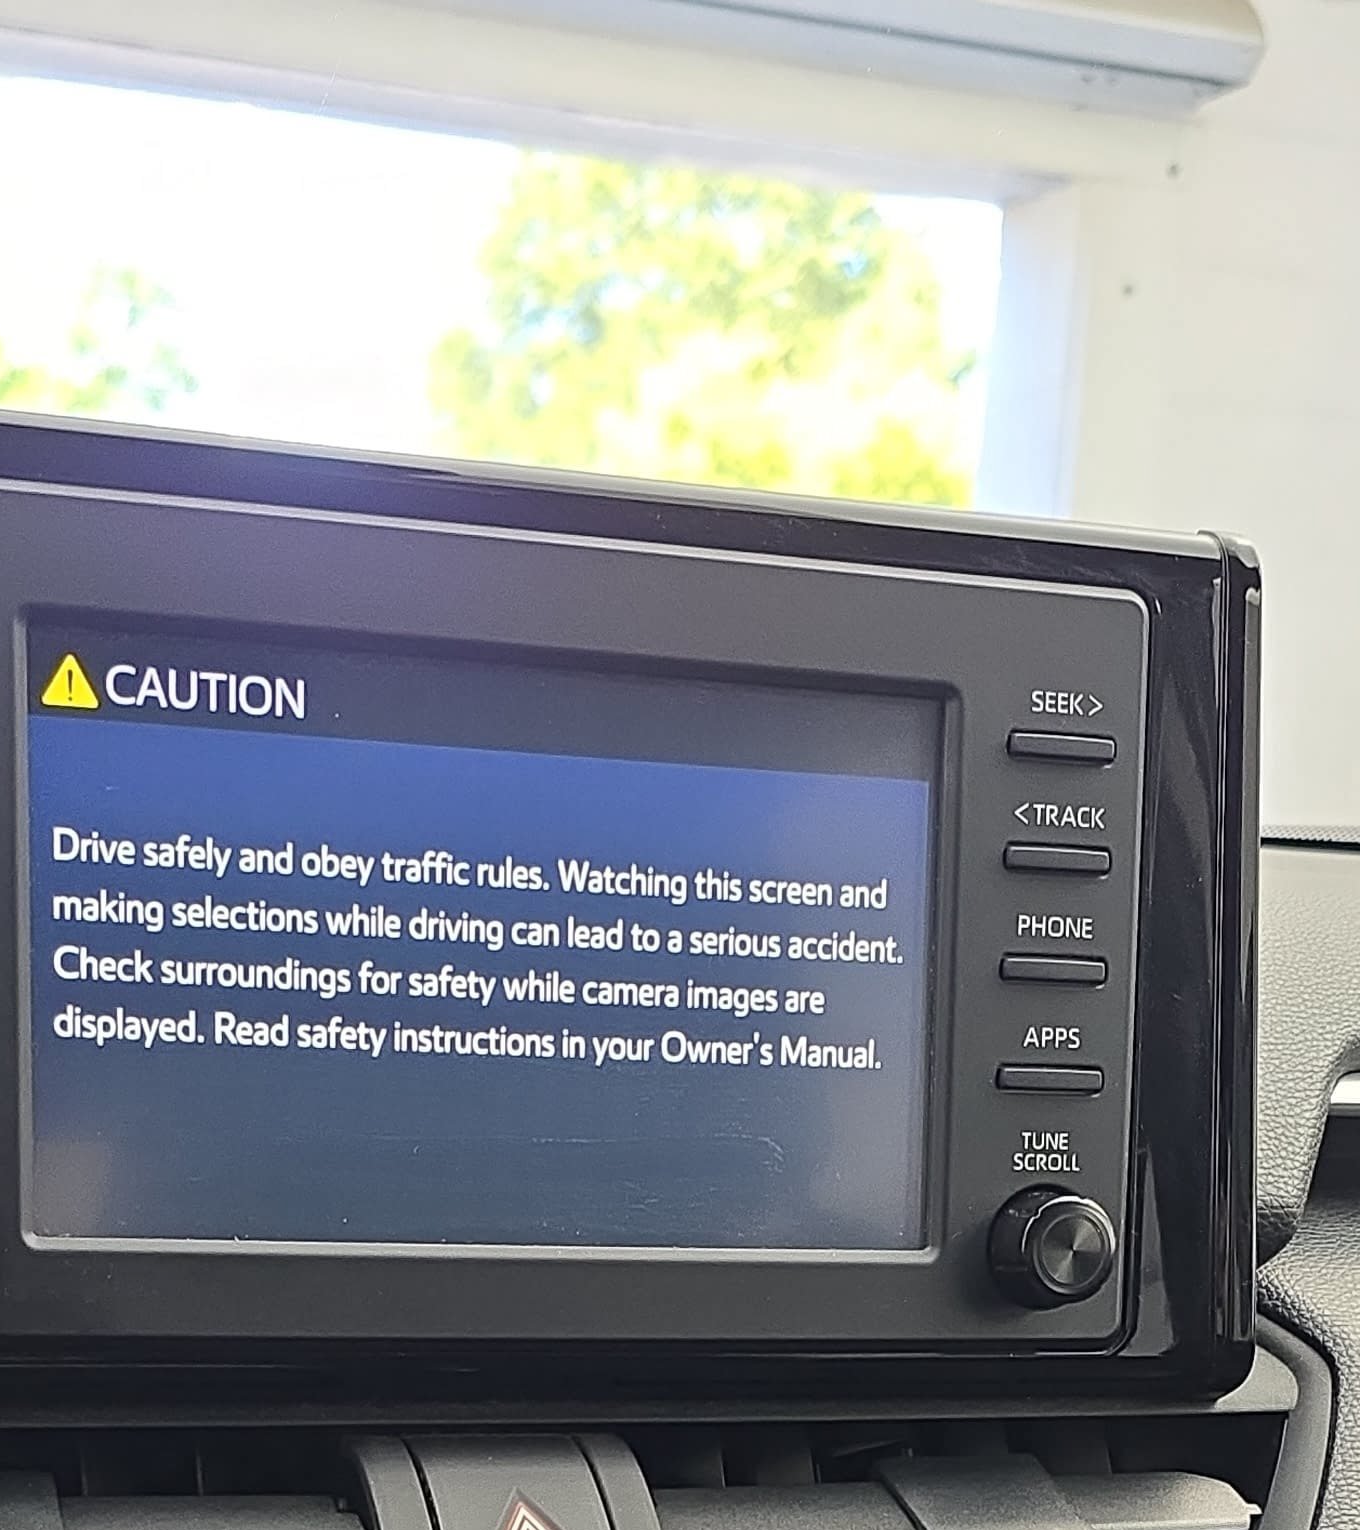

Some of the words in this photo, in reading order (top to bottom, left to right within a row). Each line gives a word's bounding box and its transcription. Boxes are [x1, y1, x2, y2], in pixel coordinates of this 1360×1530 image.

[105, 664, 305, 719] CAUTION
[52, 826, 136, 865] Drive
[143, 834, 233, 878] safely
[238, 841, 294, 875] and
[301, 845, 375, 887] obey
[380, 849, 471, 886] traffic
[477, 855, 550, 891] rules.
[557, 858, 687, 905] Watching
[693, 867, 743, 902] this
[748, 879, 833, 907] screen
[839, 877, 888, 909] and
[52, 889, 164, 933] making
[171, 895, 319, 934] selections
[325, 904, 402, 939] while
[408, 907, 504, 951] driving
[511, 921, 560, 947] can
[567, 915, 624, 951] lead
[630, 923, 661, 953] to
[667, 929, 683, 954] a
[689, 926, 782, 958] serious
[787, 930, 904, 964] accident.
[1017, 914, 1093, 939] PHONE
[53, 944, 154, 984] Check
[160, 955, 352, 999] surroundings
[357, 960, 403, 995] for
[408, 964, 497, 1007] safety
[502, 969, 576, 1004] while
[582, 981, 680, 1008] camera
[686, 978, 779, 1018] images
[784, 990, 825, 1014] are
[53, 1004, 205, 1049] displayed.
[214, 1011, 290, 1047] Read
[296, 1015, 388, 1058] safety
[393, 1021, 556, 1058] instructions
[562, 1028, 586, 1059] in
[592, 1036, 655, 1067] your
[660, 1030, 774, 1066] Owner's
[780, 1036, 882, 1070] Manual.
[1023, 1026, 1081, 1049] APPS
[1012, 1152, 1081, 1172] SCROLL
[1021, 1131, 1069, 1151] TUNE
